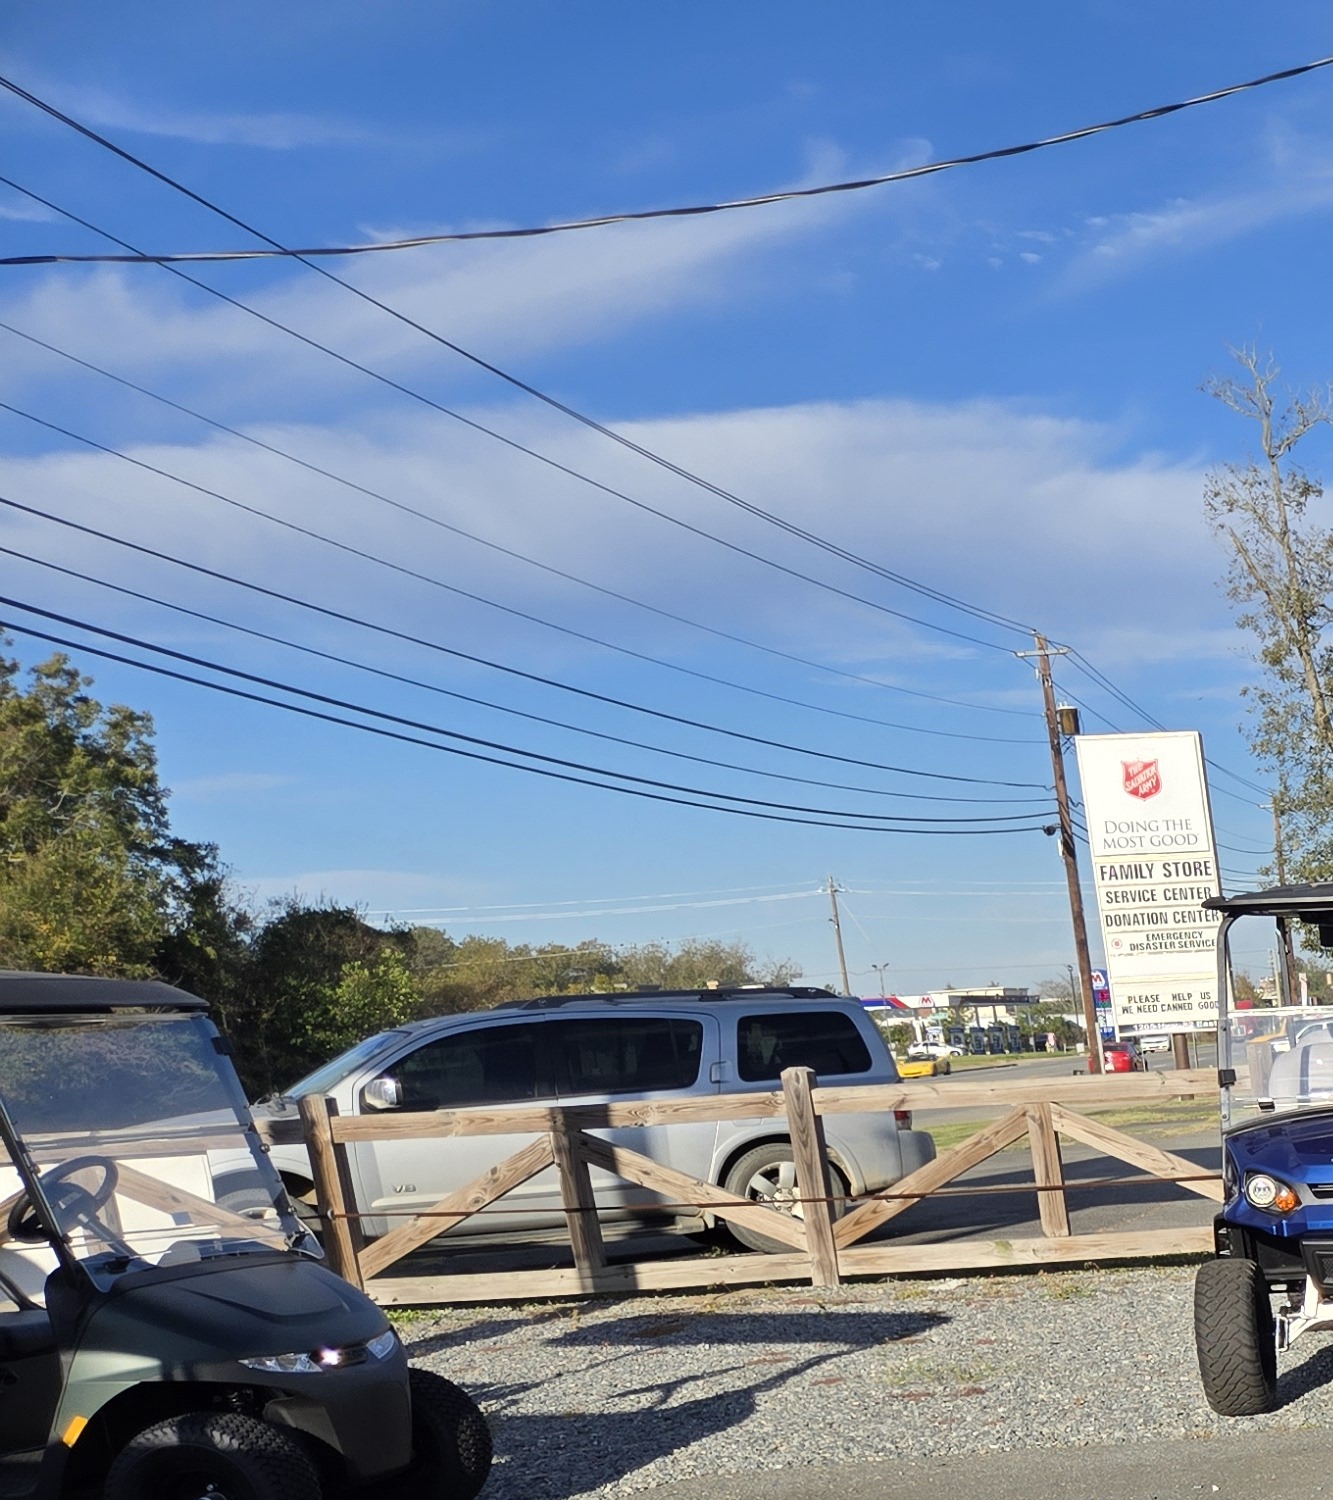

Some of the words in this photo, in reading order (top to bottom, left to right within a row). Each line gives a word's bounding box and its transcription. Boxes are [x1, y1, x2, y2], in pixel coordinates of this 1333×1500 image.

[1104, 820, 1159, 834] DOING
[1162, 819, 1192, 831] THE
[1103, 836, 1145, 850] MOST
[1149, 833, 1198, 847] GOOD
[1099, 863, 1154, 881] FAMILY
[1162, 860, 1212, 878] STORE
[1105, 889, 1157, 904] SERVICE
[1163, 886, 1212, 901] CENTER
[1105, 912, 1168, 928] DONATION
[1173, 909, 1219, 924] CENTER
[1146, 931, 1203, 942] EMERGENCY
[1129, 940, 1176, 952] DISASTER
[1128, 994, 1160, 1004] PLEASE
[1172, 993, 1193, 1002] HELP
[1200, 992, 1211, 1000] US
[1122, 1005, 1133, 1014] WE
[1137, 1005, 1158, 1014] NEED
[1161, 1003, 1193, 1012] CANNED
